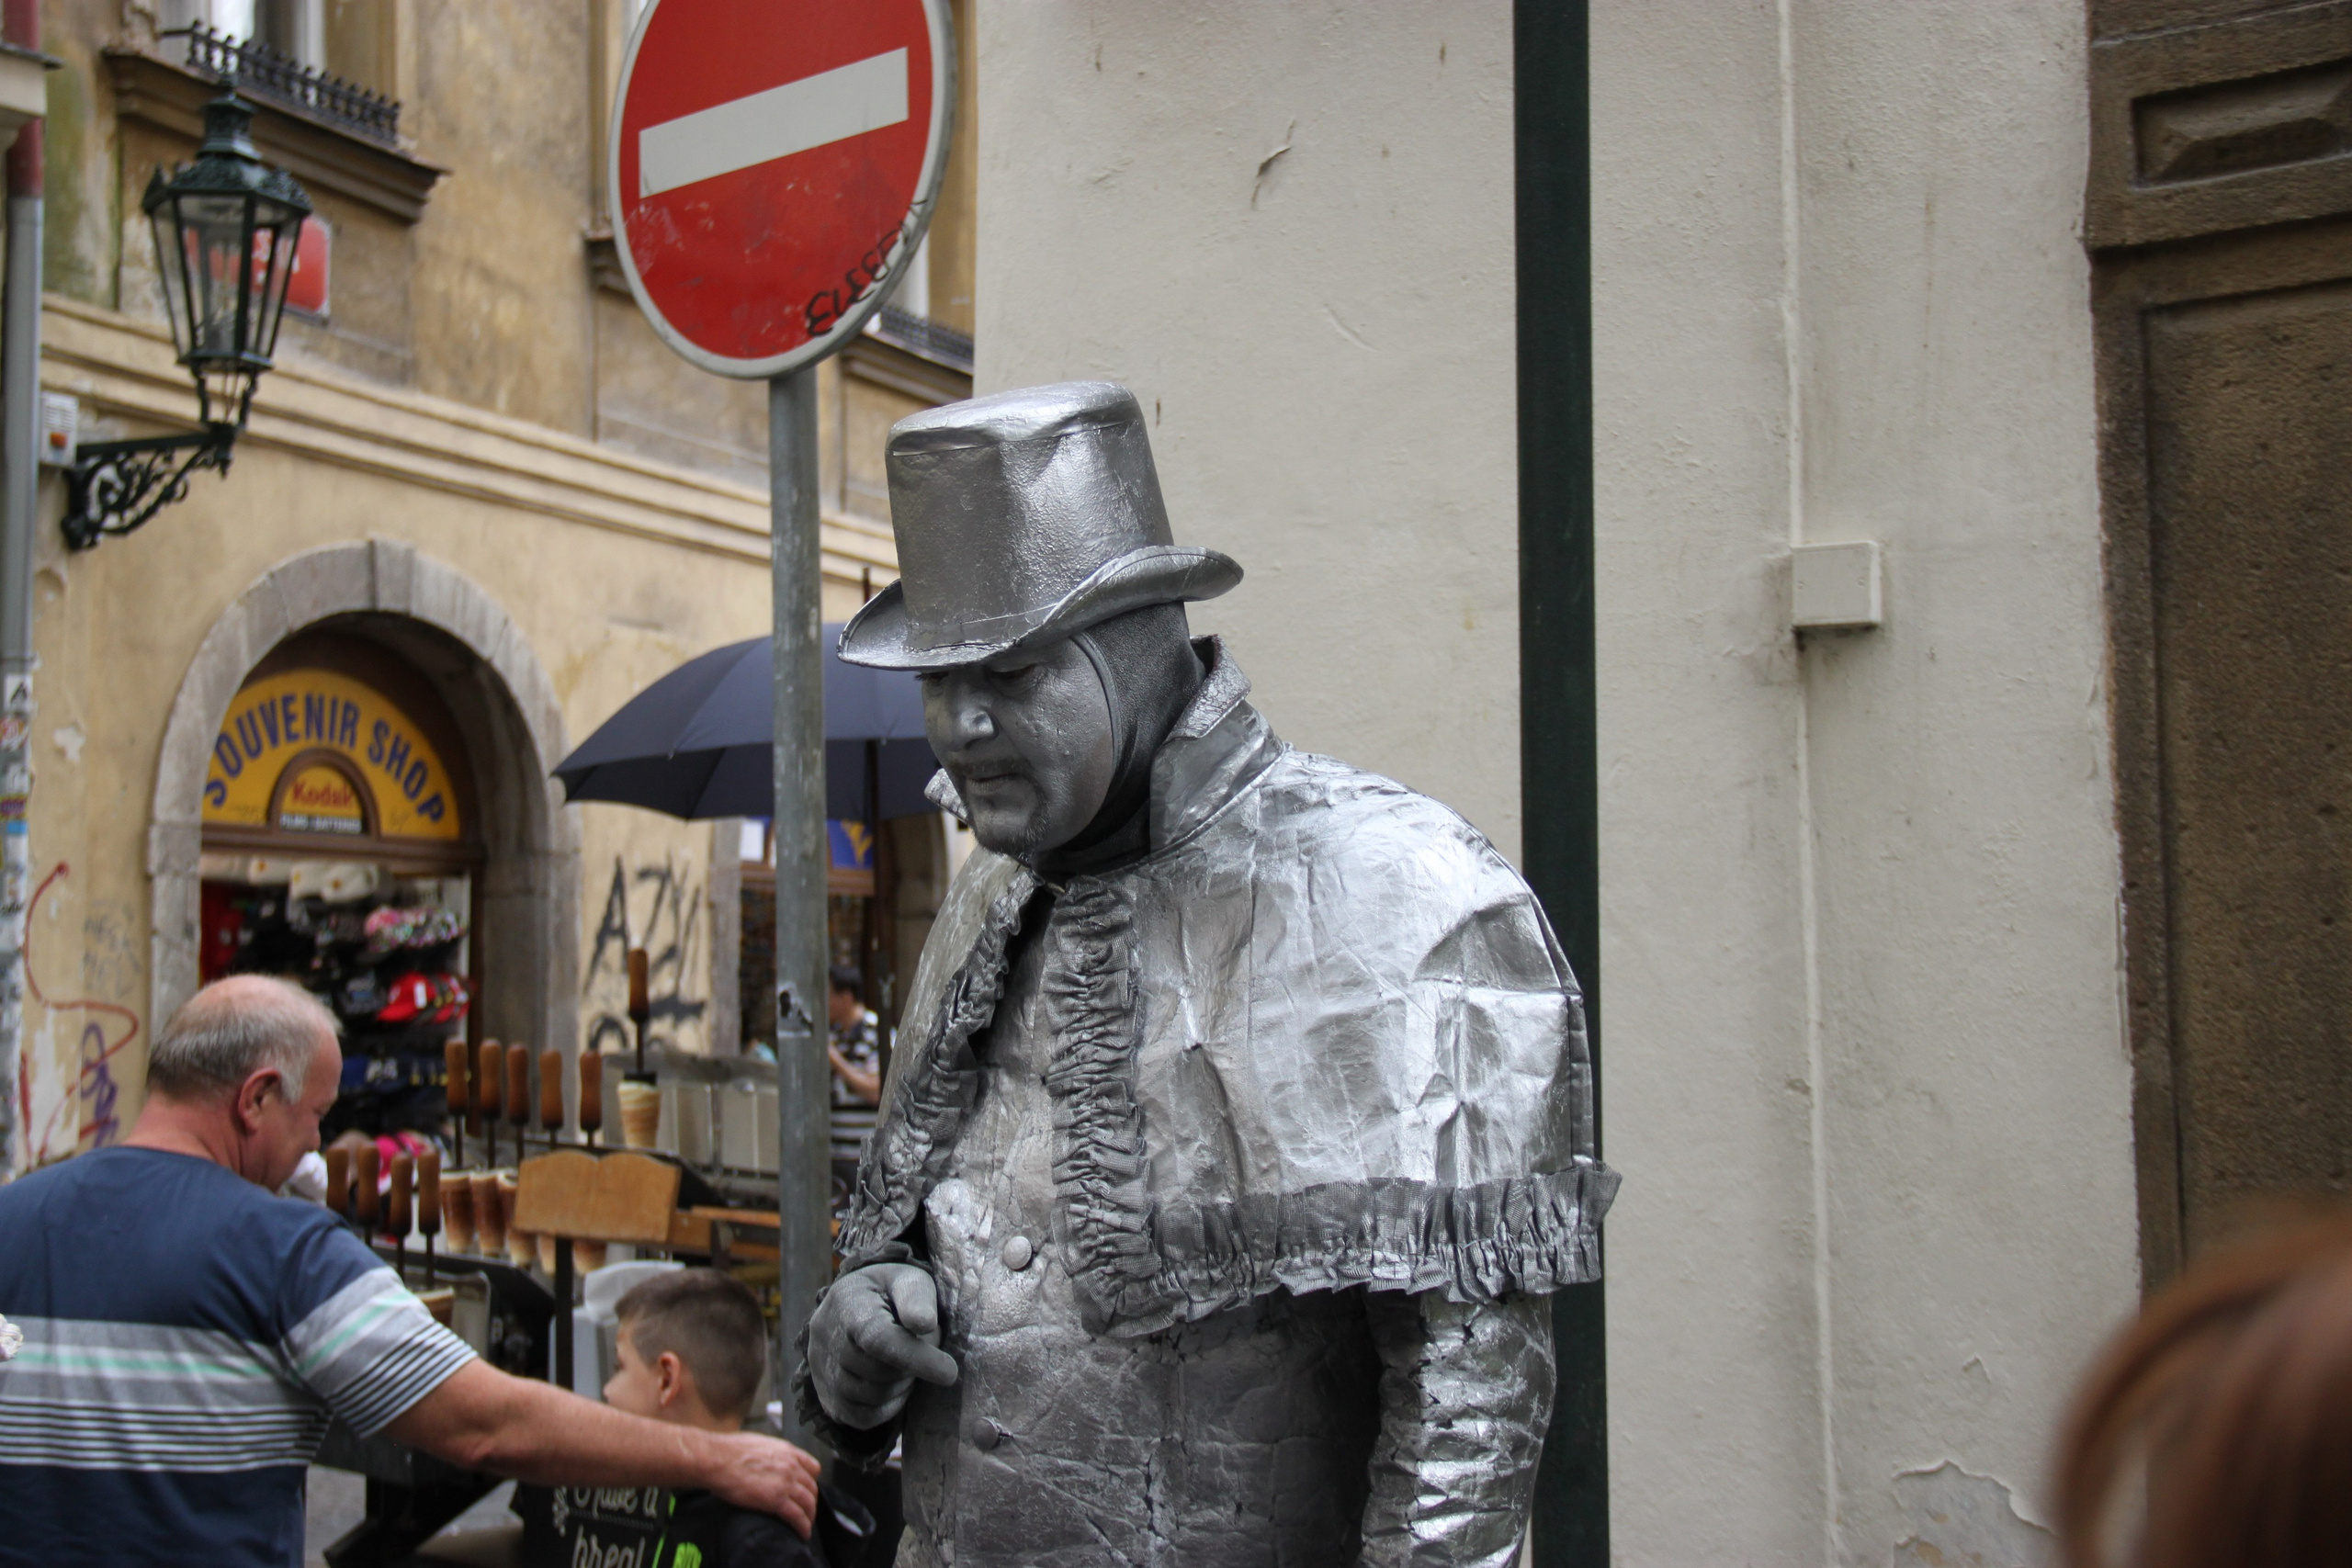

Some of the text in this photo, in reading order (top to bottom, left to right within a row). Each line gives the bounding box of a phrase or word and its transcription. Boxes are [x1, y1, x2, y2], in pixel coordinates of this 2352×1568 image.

[204, 693, 446, 823] SOUVENIR SHOP
[290, 779, 353, 807] Kodak
